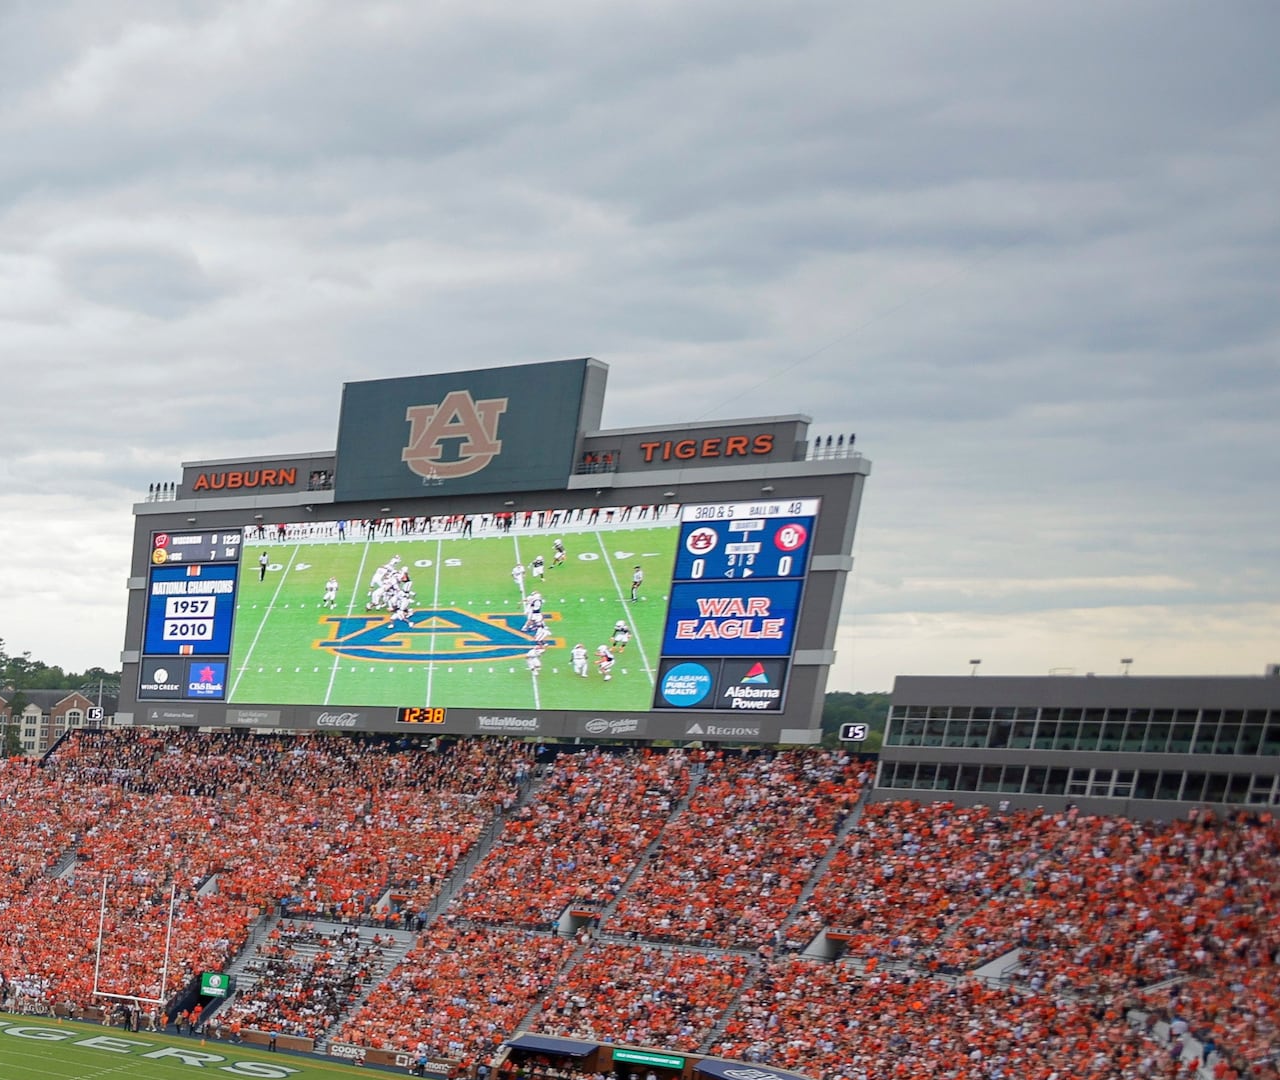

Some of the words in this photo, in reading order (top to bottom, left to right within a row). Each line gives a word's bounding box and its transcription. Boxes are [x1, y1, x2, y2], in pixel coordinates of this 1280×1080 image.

[640, 434, 774, 462] TIGERS
[193, 467, 297, 491] AUBURN
[695, 506, 715, 519] 3RD
[717, 506, 725, 518] &
[727, 505, 734, 518] 5
[749, 506, 765, 516] BALL
[767, 505, 779, 515] ON
[788, 502, 802, 515] 48
[727, 555, 736, 566] 3
[746, 554, 755, 566] 3
[692, 559, 705, 579] 0
[778, 556, 792, 576] 0
[152, 582, 187, 595] NATIONAL
[188, 580, 233, 594] CHAMPIONS
[173, 600, 209, 614] 1957
[697, 597, 771, 617] WAR
[169, 623, 207, 637] 2010
[675, 618, 785, 640] EAGLE
[664, 688, 697, 696] HEALTH
[725, 687, 780, 698] Alabama
[731, 698, 770, 709] Power
[91, 709, 101, 719] 15
[403, 708, 444, 723] 12:38
[609, 719, 638, 728] Golden
[611, 726, 636, 734] Flake
[706, 725, 760, 736] REGIONS
[848, 726, 864, 738] 15
[331, 1044, 366, 1058] COOK'S
